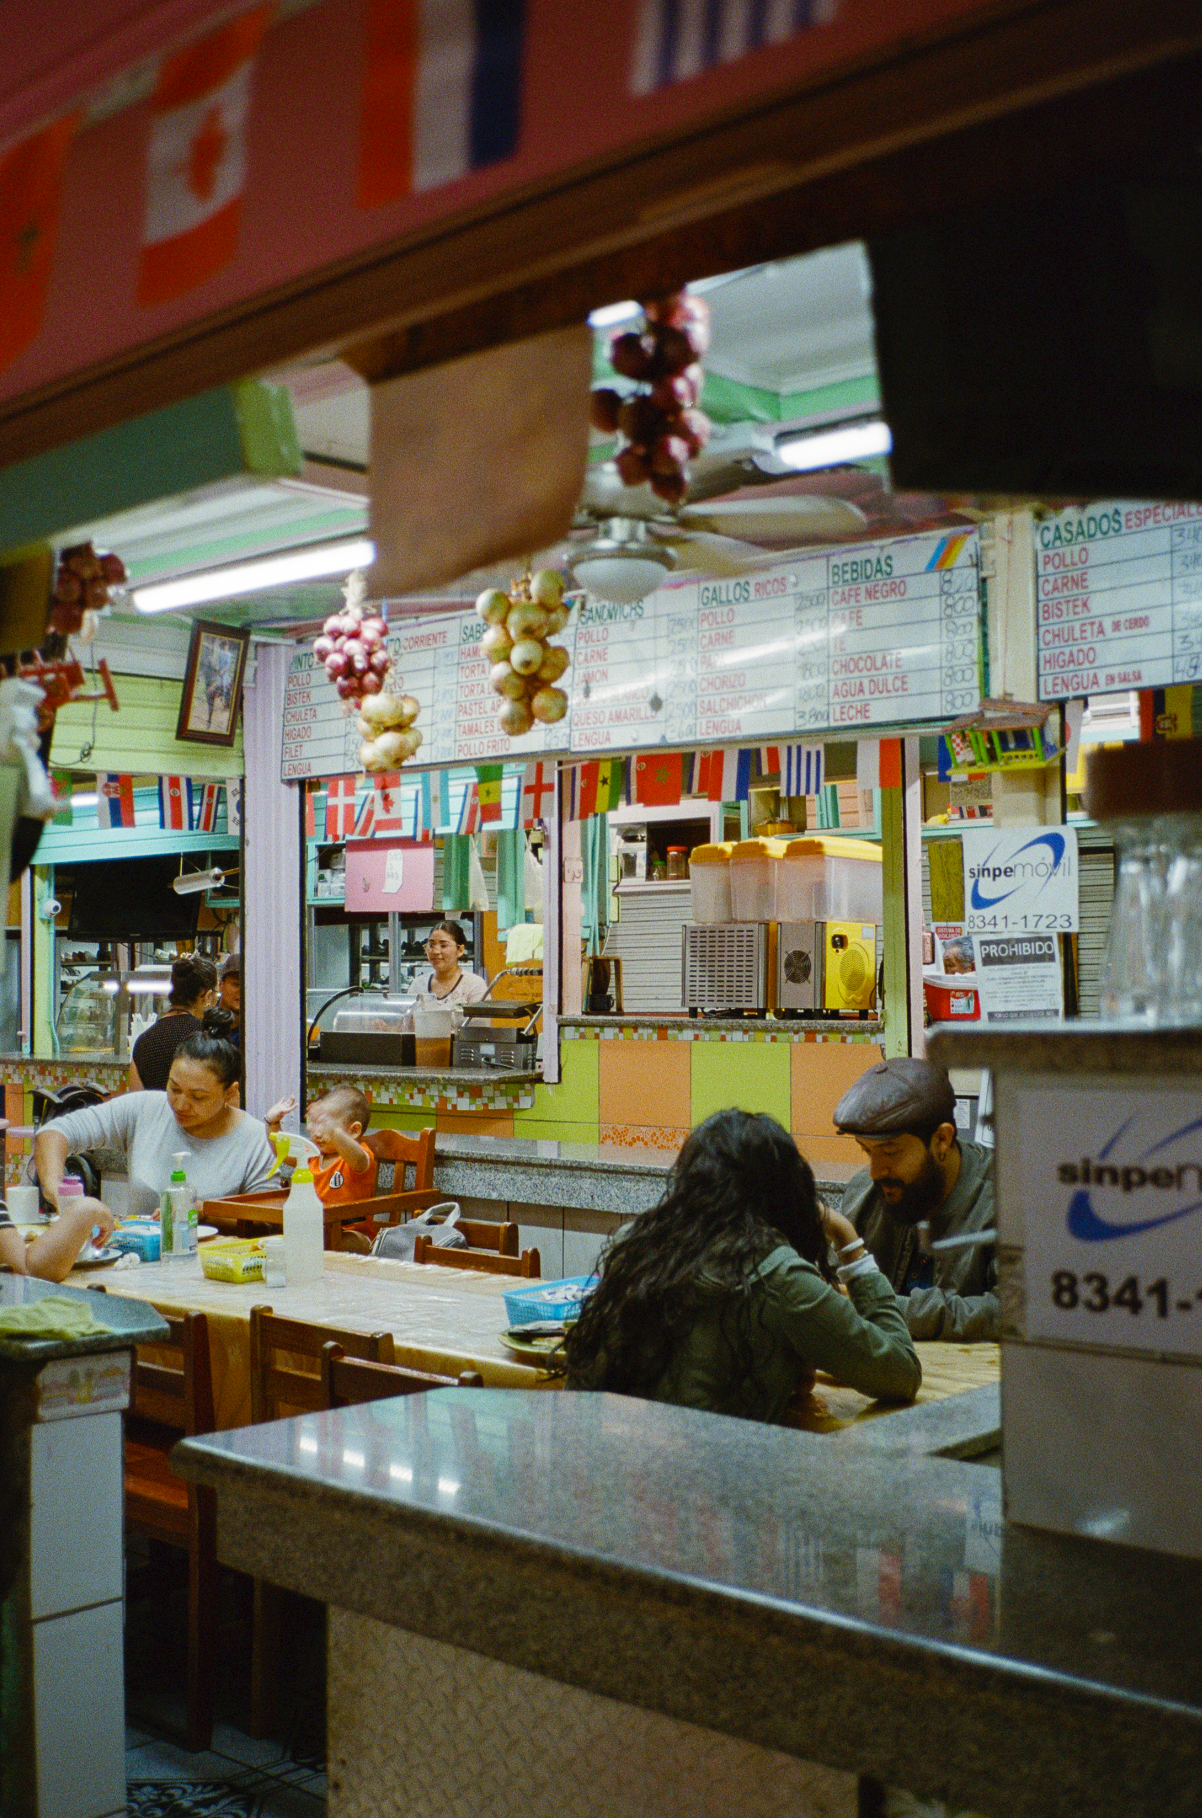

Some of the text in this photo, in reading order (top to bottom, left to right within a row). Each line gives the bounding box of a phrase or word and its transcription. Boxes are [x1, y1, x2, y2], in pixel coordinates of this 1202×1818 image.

[1040, 507, 1122, 548] CASADOS
[1042, 547, 1089, 571] POLLO
[831, 554, 893, 585] BEBIDAS
[701, 576, 788, 607] GALLOS RICOS
[831, 579, 907, 606] CAFE NEGRO
[1042, 571, 1089, 597] CARNE
[579, 599, 645, 625] SANDWICHS
[700, 607, 735, 627] POLLO
[831, 608, 863, 627] CAFE
[1042, 596, 1091, 622] BISTEK
[403, 630, 448, 651] CORRIENTE
[578, 627, 609, 644] POLLO
[700, 629, 735, 650] CARNE
[1042, 619, 1106, 647] CHULETA
[1111, 618, 1122, 633] DE
[833, 636, 846, 653] TE
[576, 647, 609, 666] CARNE
[832, 651, 903, 676] CHOCOLATE
[1043, 646, 1097, 672] HIGADO
[287, 672, 311, 689] POLLO
[460, 662, 486, 680] TORTA
[575, 668, 609, 687] JAMON
[459, 682, 485, 699] TORTA
[700, 672, 746, 693] CHORIZO
[832, 674, 909, 699] AGUA DULCE
[1043, 671, 1100, 696] LENGUA
[1118, 669, 1142, 684] SALSA
[286, 690, 312, 708] BISTEK
[284, 707, 318, 724] CHULETA
[458, 701, 488, 718] PASTEL
[573, 710, 606, 727] QUESO
[832, 702, 871, 723] LECHE
[284, 725, 312, 742] HIGADO
[458, 719, 495, 737] TAMALES
[700, 719, 742, 737] LENGUA
[457, 740, 485, 757] POLLO
[487, 737, 511, 753] FRITO
[572, 730, 611, 748] LENGUA
[284, 743, 304, 759] FILET
[283, 761, 312, 778] LENGUA
[968, 913, 1073, 930] 8341-1723
[981, 941, 1054, 958] PROHIBIDO
[1051, 1269, 1202, 1320] 8341-
